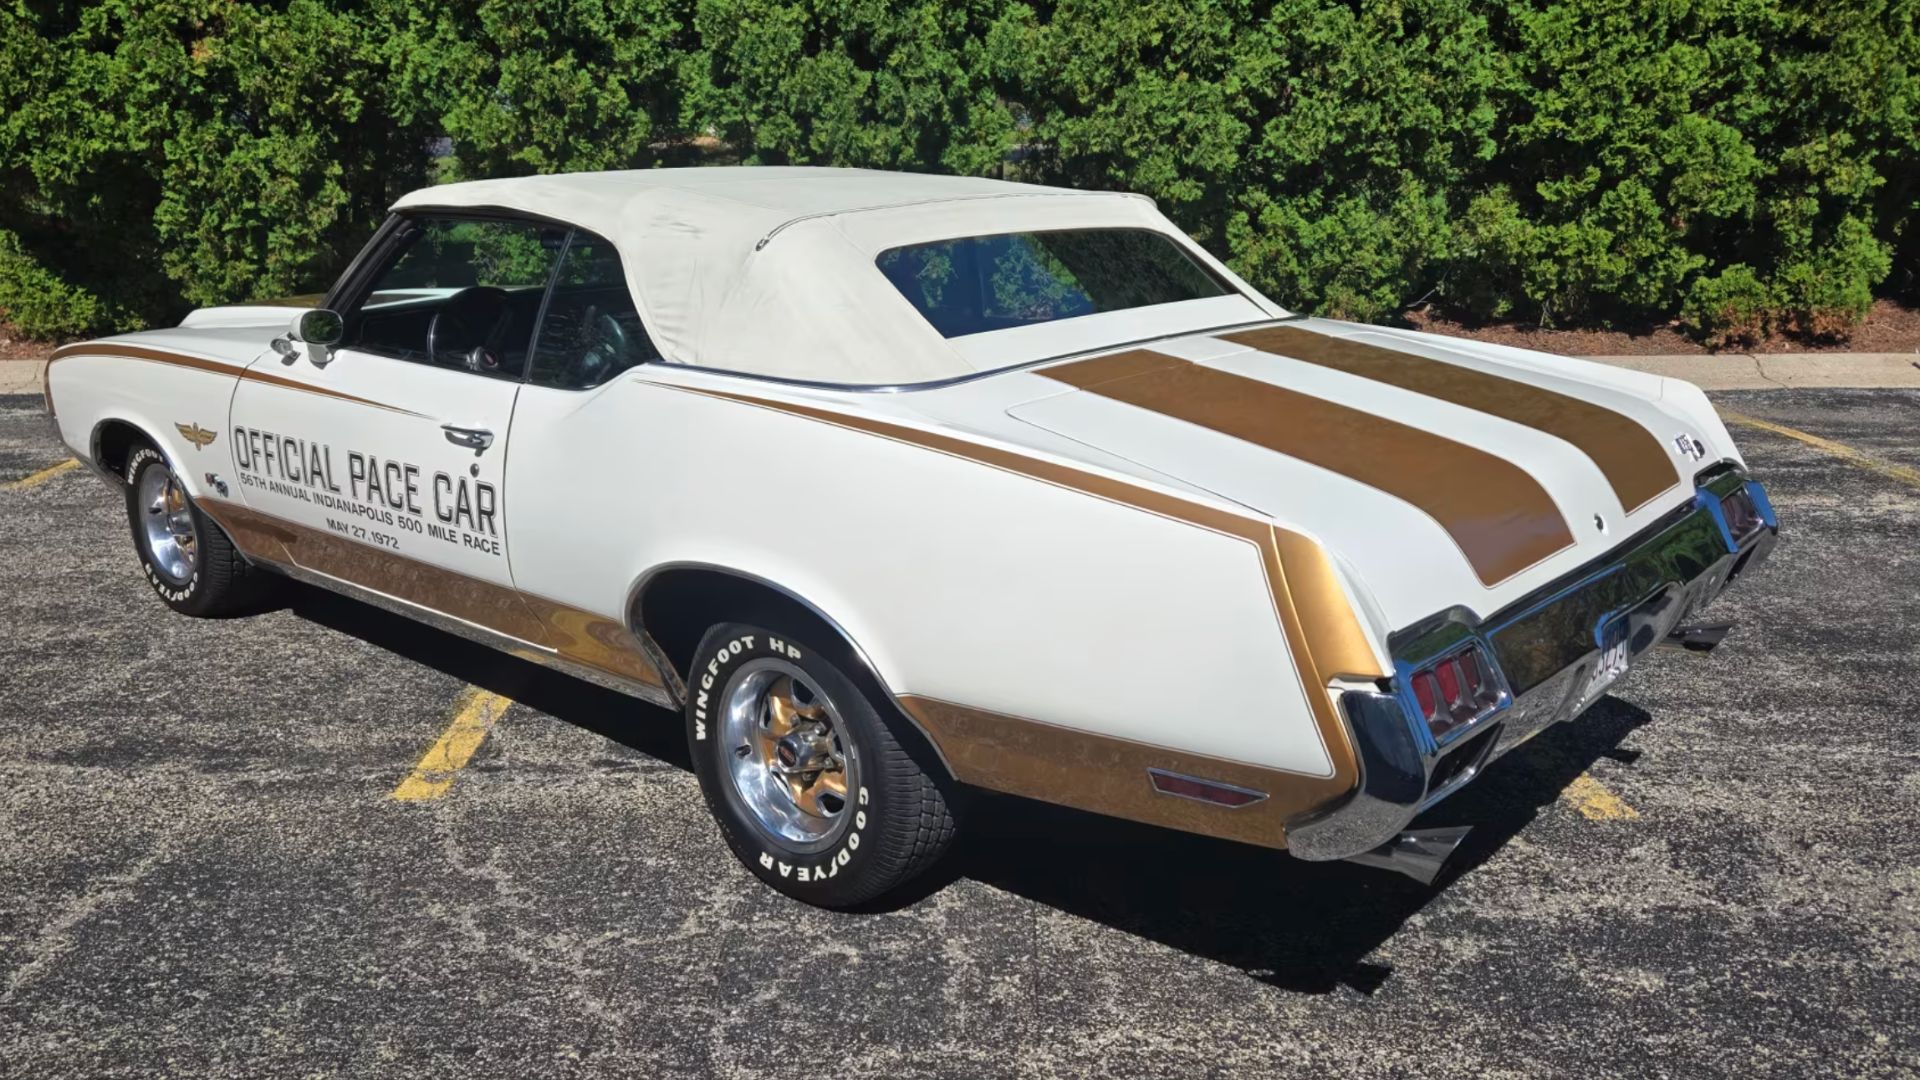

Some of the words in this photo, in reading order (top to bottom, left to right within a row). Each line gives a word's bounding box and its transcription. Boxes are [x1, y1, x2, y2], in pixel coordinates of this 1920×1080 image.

[234, 425, 342, 495] OFFICIAL
[347, 450, 423, 517] PACE
[433, 470, 499, 538] CAR
[240, 472, 267, 492] 56TH
[269, 480, 311, 503] ANNUAL
[312, 491, 394, 526] INDIANAPOLIS
[398, 515, 423, 534] 500
[427, 523, 458, 544] MILE
[462, 533, 501, 556] RACE
[326, 517, 349, 534] MAY
[696, 635, 755, 741] WINGFOOT
[769, 636, 802, 660] HP
[759, 786, 869, 882] GOODYEAR
